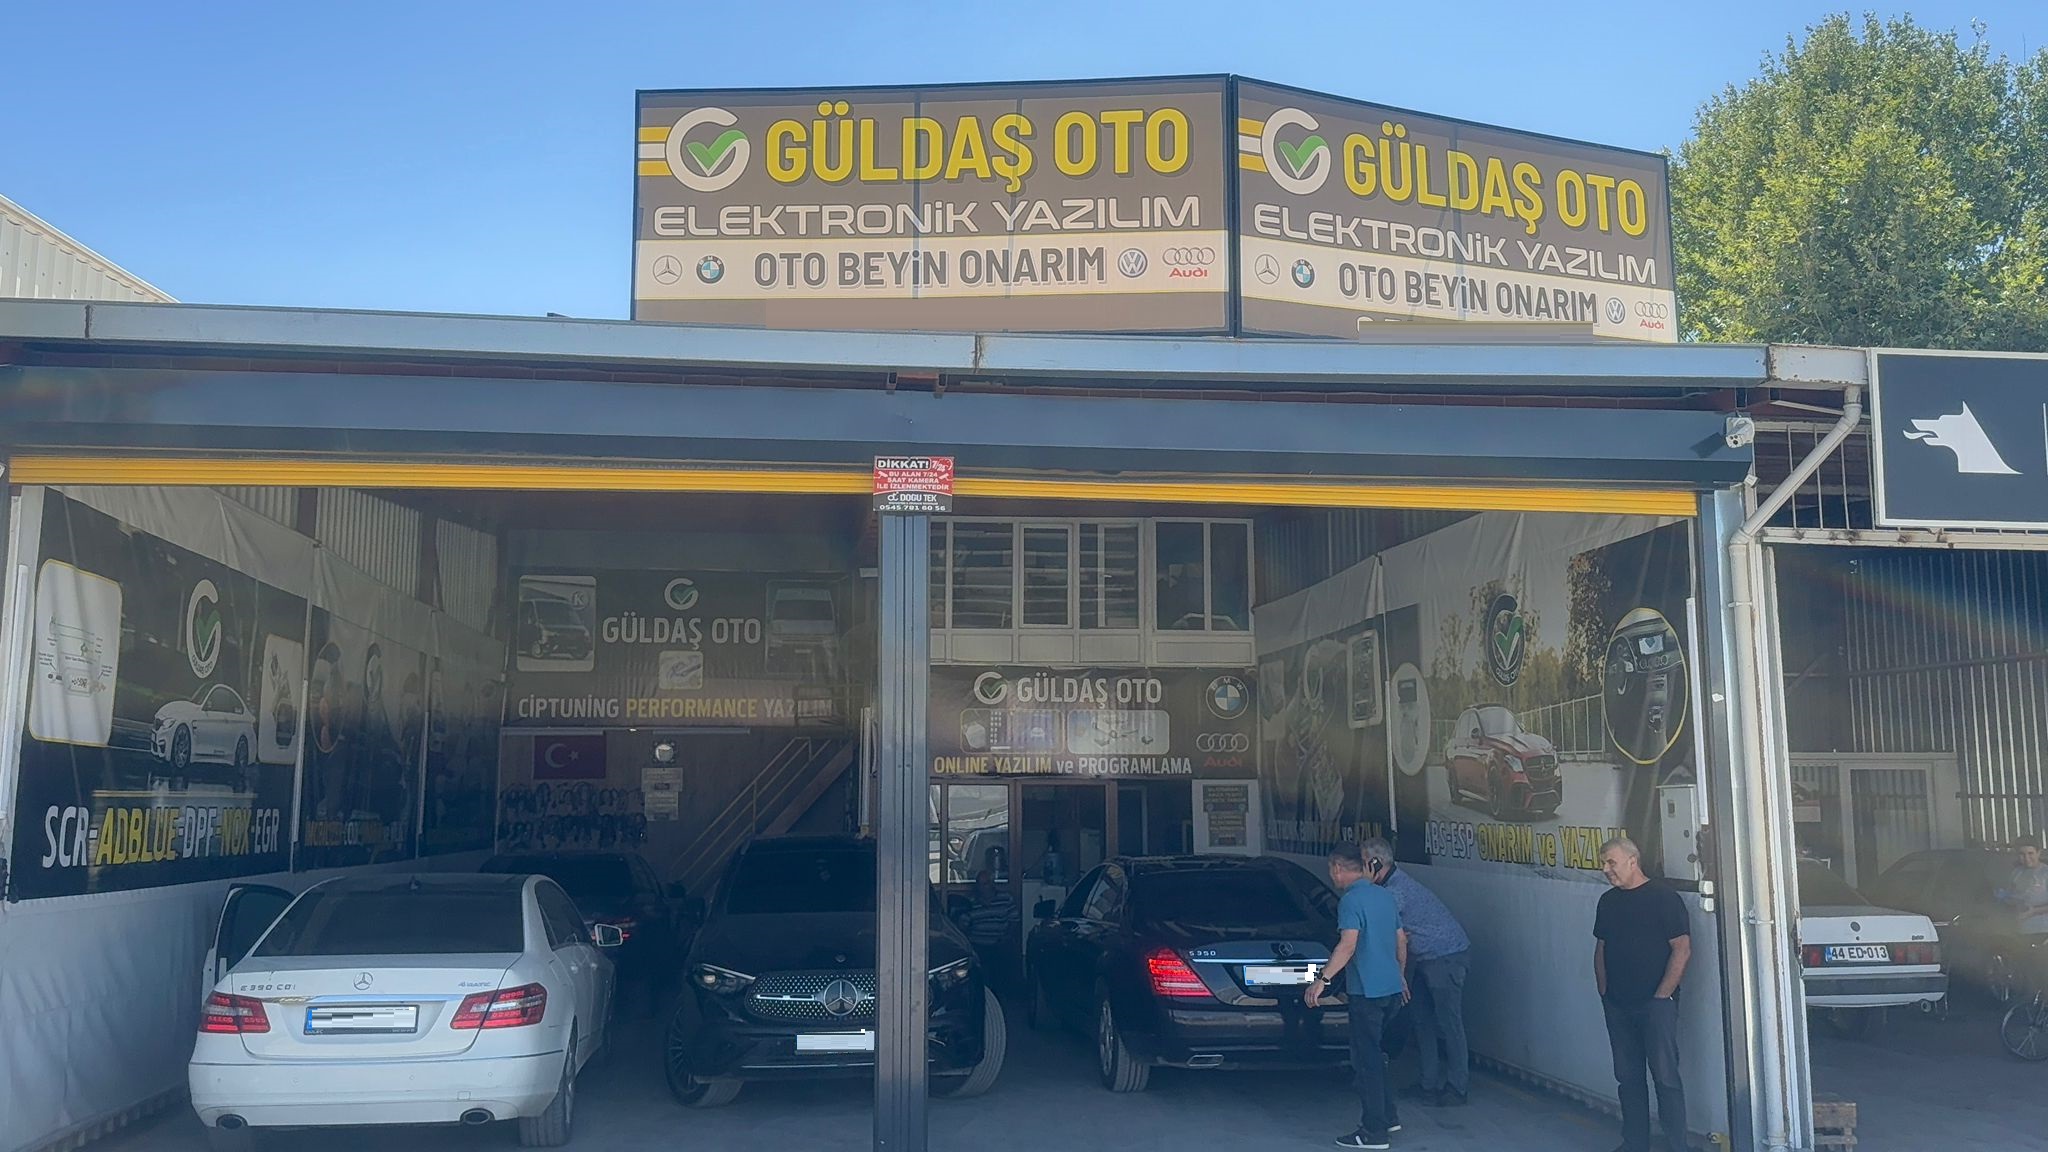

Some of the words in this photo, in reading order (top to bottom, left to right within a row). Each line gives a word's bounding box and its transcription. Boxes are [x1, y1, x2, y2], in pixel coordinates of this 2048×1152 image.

[765, 101, 1034, 193] GÜLDAŞ
[1052, 107, 1189, 177] OTO
[1343, 121, 1543, 234] GÜLDAŞ
[1556, 169, 1647, 236] OTO
[991, 196, 1200, 231] YAZILIM
[754, 252, 826, 288] OTO
[959, 246, 1105, 285] ONARIM
[1169, 267, 1208, 278] Audi
[1518, 239, 1657, 285] YAZILIM
[1338, 262, 1395, 301] OTO
[1496, 281, 1597, 323] ONARIM
[878, 459, 929, 469] DİKKAT!
[923, 494, 937, 502] TEK
[603, 611, 703, 650] GÜLDAŞ
[711, 618, 761, 644] OTO
[1017, 672, 1107, 708] GÜLDAŞ
[1117, 679, 1162, 703] OTO
[626, 698, 757, 719] PERFORMANCE
[934, 757, 988, 774] ONLINE
[994, 757, 1052, 774] YAZILIM
[1056, 760, 1073, 774] ve
[1078, 757, 1192, 775] PROGRAMLAMA
[1477, 823, 1534, 865] ONARIM
[1536, 832, 1557, 867] ve
[1831, 947, 1845, 960] 44
